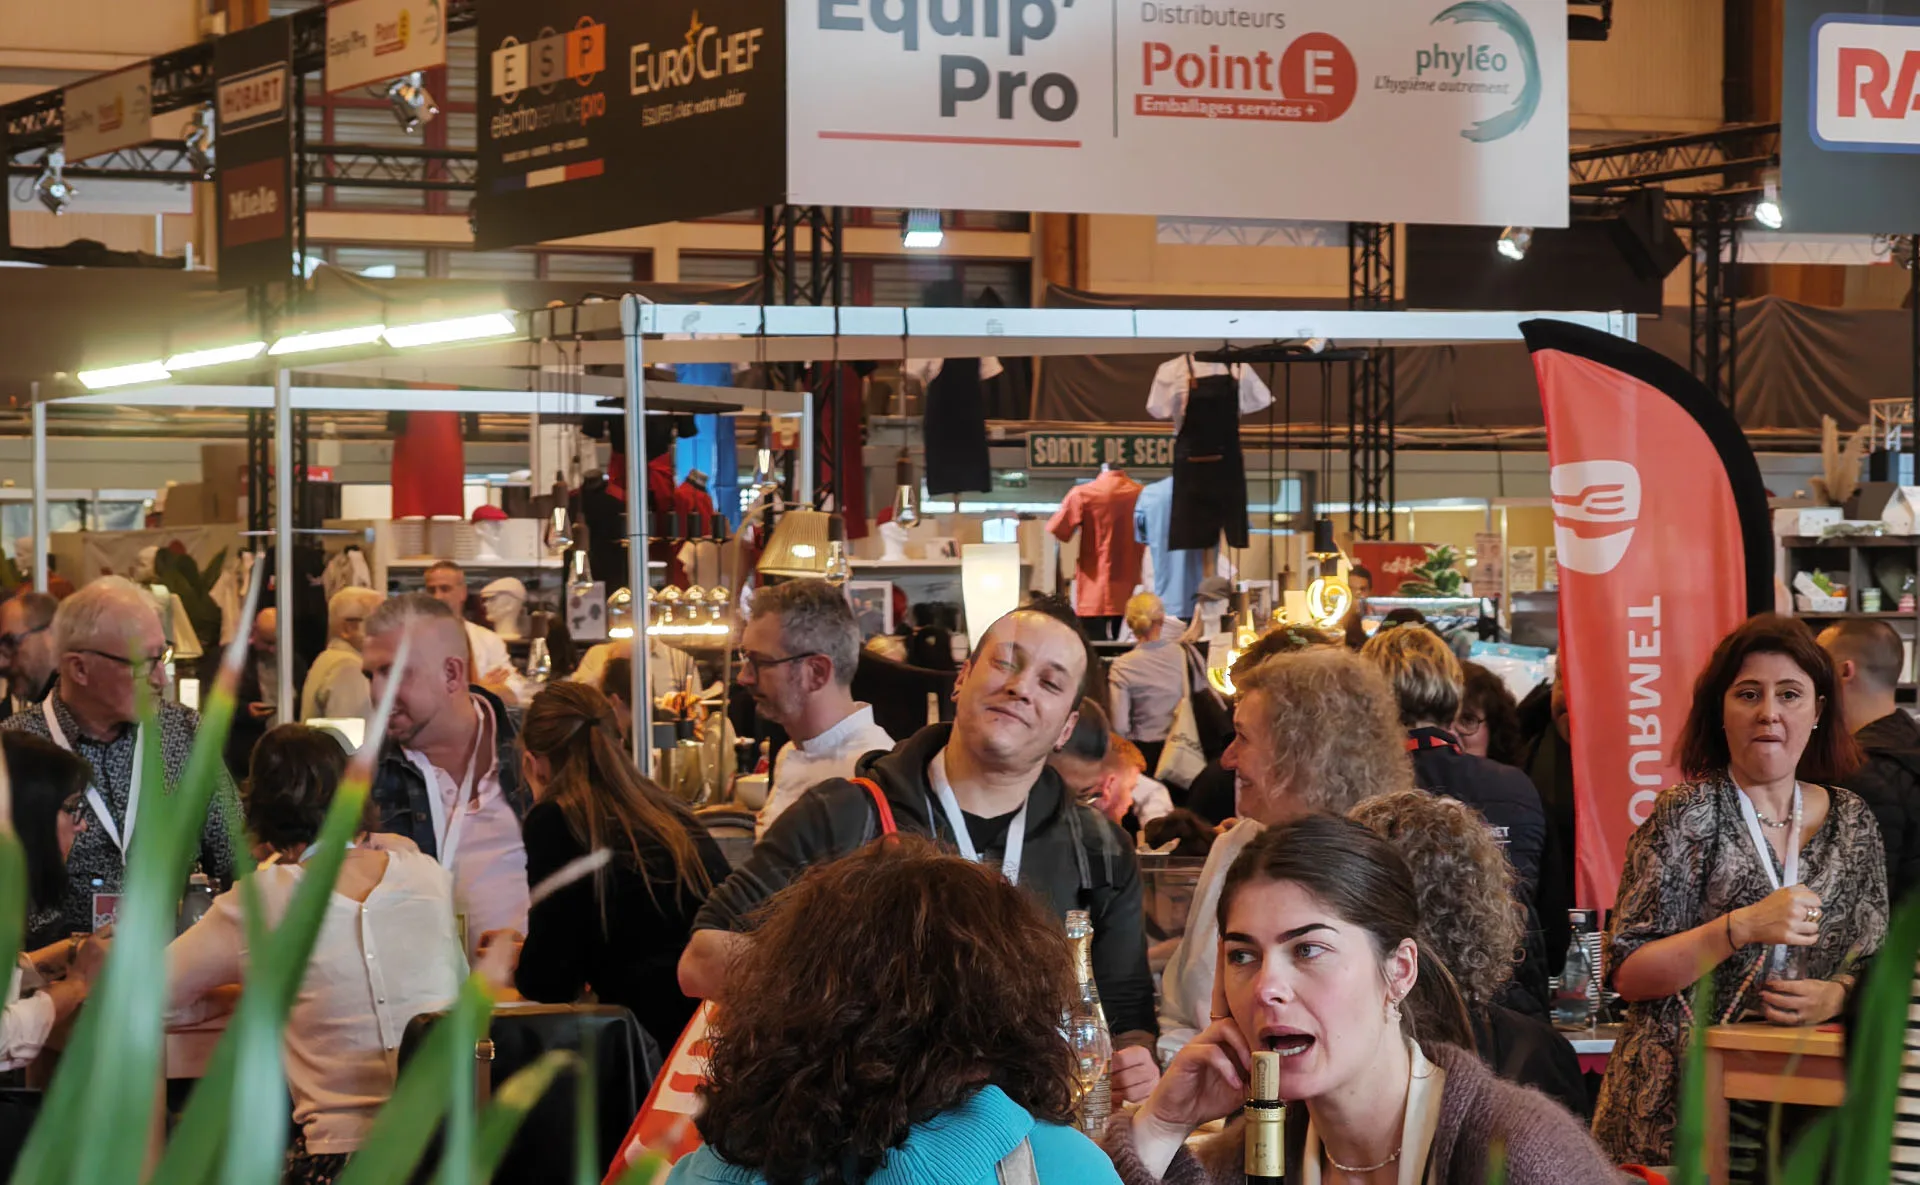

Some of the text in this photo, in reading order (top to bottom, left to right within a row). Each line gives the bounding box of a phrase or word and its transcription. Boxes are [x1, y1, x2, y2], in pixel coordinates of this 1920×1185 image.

[1141, 2, 1286, 29] Distributeurs
[1142, 41, 1335, 95] Point E
[1416, 43, 1507, 77] phyléo
[939, 54, 1079, 122] Pro
[1141, 96, 1234, 118] Emballages
[1238, 102, 1302, 117] services
[229, 186, 277, 220] Miele
[1033, 436, 1098, 465] SORTIE
[1103, 437, 1127, 464] DE
